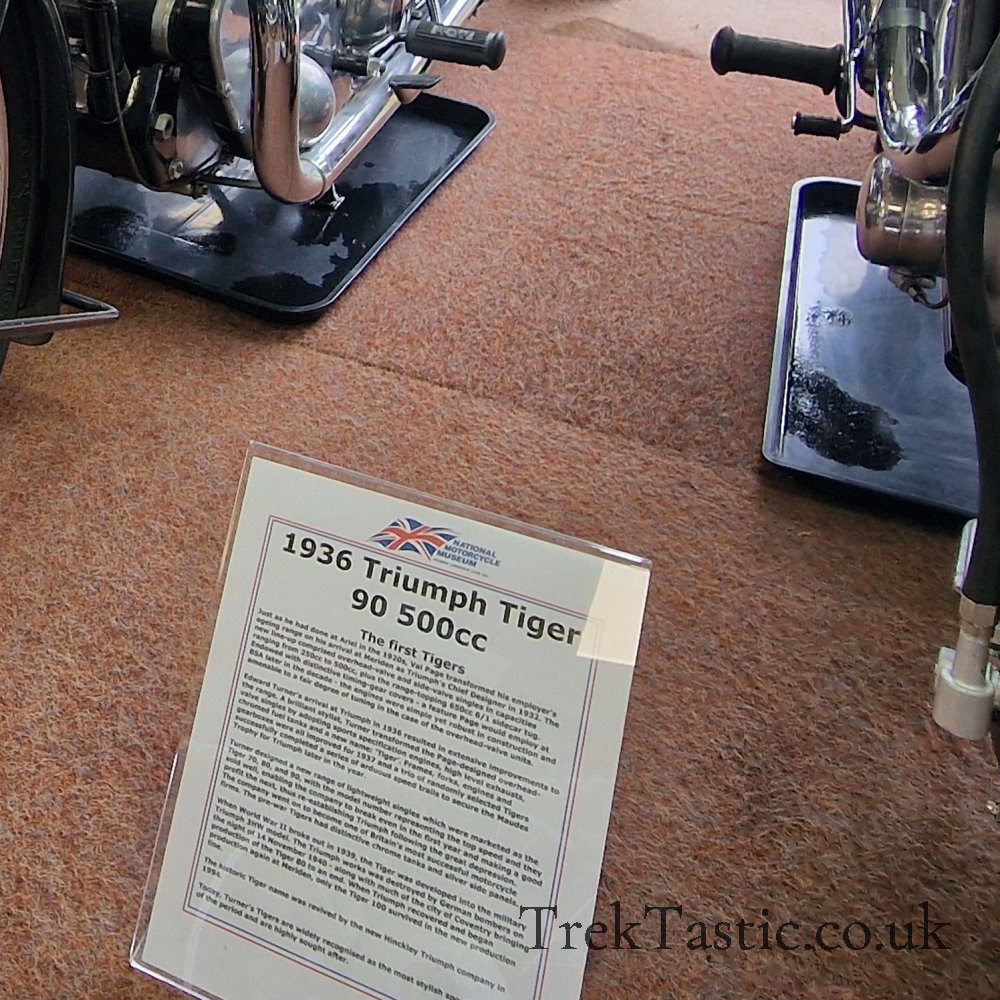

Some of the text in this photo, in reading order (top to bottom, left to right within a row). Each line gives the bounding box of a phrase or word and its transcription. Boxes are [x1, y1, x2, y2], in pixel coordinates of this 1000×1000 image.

[282, 533, 352, 572] 1936
[363, 556, 487, 616] Triumph
[500, 600, 582, 646] Tiger
[437, 550, 477, 568] MUSEUM
[444, 544, 501, 567] MOTORCYCLE
[453, 540, 497, 559] NATIONAL
[256, 616, 281, 631] ageing
[281, 626, 303, 638] range
[315, 636, 327, 646] his
[328, 641, 353, 655] arrival
[363, 653, 394, 670] Meriden
[447, 683, 469, 696] Chief
[470, 691, 506, 710] Designer
[544, 716, 560, 729] The
[258, 608, 273, 619] Just
[294, 620, 309, 631] had
[310, 626, 329, 638] done
[339, 636, 358, 648] Ariel
[368, 646, 381, 656] the
[410, 660, 423, 671] Val
[424, 665, 445, 679] Page
[446, 673, 496, 697] transformed
[497, 690, 510, 702] his
[351, 588, 488, 653] 90 500cc
[360, 629, 466, 675] The first Tigers
[254, 625, 270, 635] new
[270, 629, 297, 645] line-up
[297, 640, 336, 659] comprised
[337, 654, 396, 680] overhead-valve
[396, 674, 412, 685] and
[413, 680, 454, 700] side-valve
[455, 695, 484, 712] singles
[495, 709, 537, 731] capacities
[240, 689, 259, 702] valve
[260, 697, 287, 712] singles
[298, 711, 332, 730] adopting
[332, 724, 358, 739] sports
[358, 734, 407, 758] specification
[444, 765, 463, 779] high
[464, 773, 484, 786] level
[243, 672, 271, 688] Edward
[303, 695, 329, 710] arrival
[339, 707, 372, 726] Triumph
[382, 723, 403, 737] 1936
[403, 732, 437, 750] resulted
[447, 748, 488, 769] extensive
[488, 763, 549, 792] improvements
[223, 764, 244, 778] profit
[245, 771, 258, 783] the
[279, 785, 297, 798] thus
[297, 793, 355, 823] re-establishing
[356, 816, 389, 836] Triumph
[390, 830, 428, 852] following
[429, 845, 444, 857] the
[444, 852, 467, 868] great
[243, 788, 257, 800] The
[257, 796, 288, 813] pre-war
[289, 807, 313, 824] Tigers
[313, 817, 329, 830] had
[329, 824, 371, 847] distinctive
[371, 842, 402, 860] chrome
[403, 854, 426, 870] tanks
[427, 864, 443, 877] and
[444, 872, 468, 887] silver
[469, 881, 488, 895] side
[215, 805, 245, 824] Triumph
[292, 837, 307, 849] The
[308, 843, 341, 864] Triumph
[342, 858, 367, 874] works
[367, 870, 384, 882] was
[385, 876, 426, 900] destroyed
[439, 898, 472, 918] German
[474, 912, 511, 935] bombers
[204, 856, 218, 868] The
[218, 862, 247, 881] historic
[247, 875, 267, 890] Tiger
[268, 885, 290, 900] name
[291, 895, 307, 907] was
[308, 902, 337, 920] revived
[349, 919, 364, 932] the
[364, 927, 382, 940] new
[383, 934, 419, 957] Hinckley
[420, 950, 455, 973] Triumph
[456, 967, 495, 990] company
